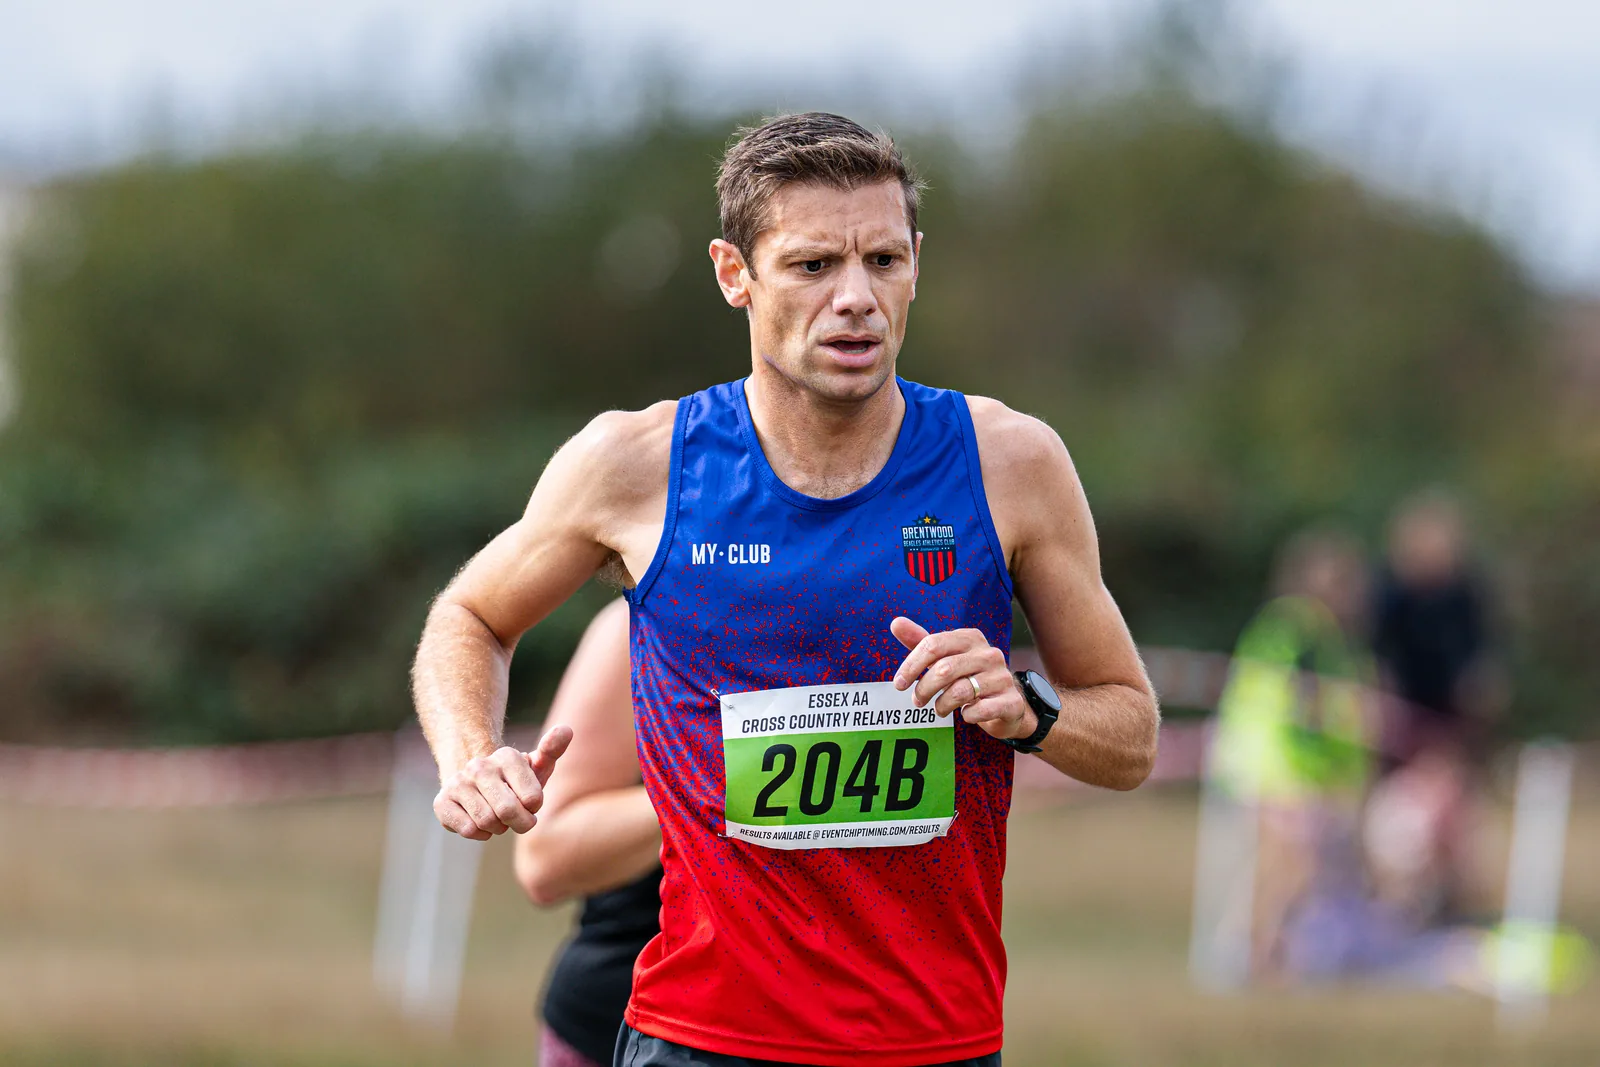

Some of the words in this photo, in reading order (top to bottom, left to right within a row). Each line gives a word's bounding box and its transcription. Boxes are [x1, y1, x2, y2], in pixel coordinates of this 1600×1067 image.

[902, 526, 954, 539] BRENTWOOD
[943, 538, 955, 546] CLUB
[808, 692, 849, 709] ESSEX
[852, 690, 869, 707] AA
[742, 715, 786, 734] CROSS
[789, 711, 850, 730] COUNTRY
[853, 709, 902, 727] RELAYS
[904, 707, 936, 725] 2026
[753, 738, 930, 818] 204B
[740, 828, 772, 840] RESULTS
[772, 830, 812, 841] AVAILABLE
[813, 829, 820, 841] @
[821, 823, 941, 839] EVENTCHIPTIMING.COM/RESULTS
